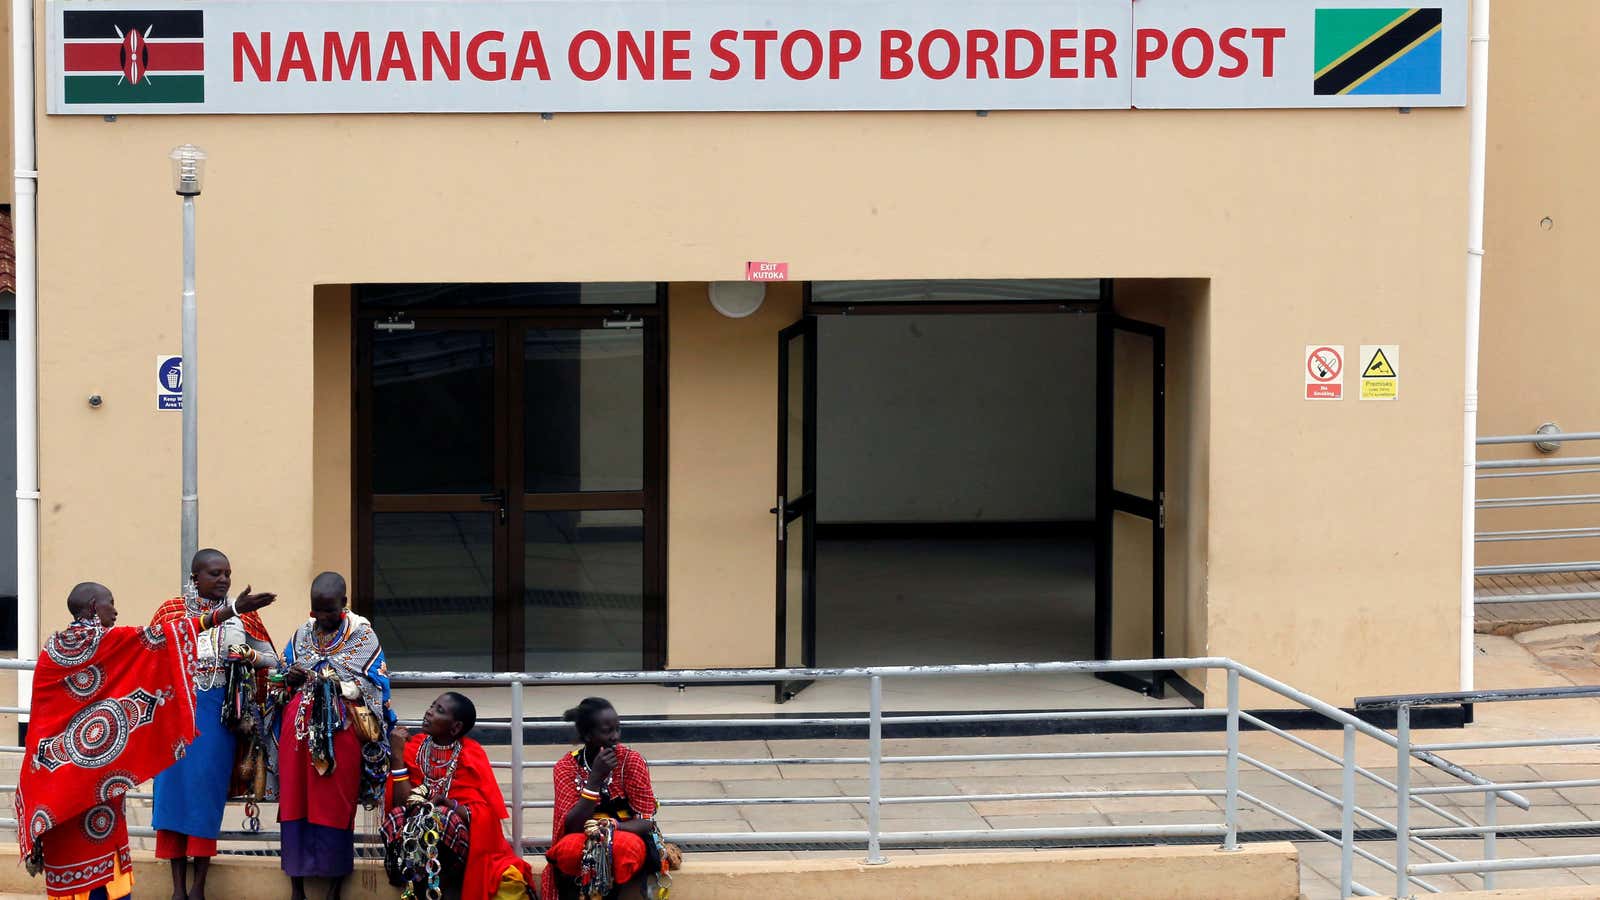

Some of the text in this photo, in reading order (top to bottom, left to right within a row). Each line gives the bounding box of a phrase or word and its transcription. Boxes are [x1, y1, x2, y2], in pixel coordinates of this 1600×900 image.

[233, 27, 1286, 83] NAMANGA ONE STOP BORDER POST
[760, 263, 777, 271] EXIT
[753, 271, 784, 279] KUTOKA
